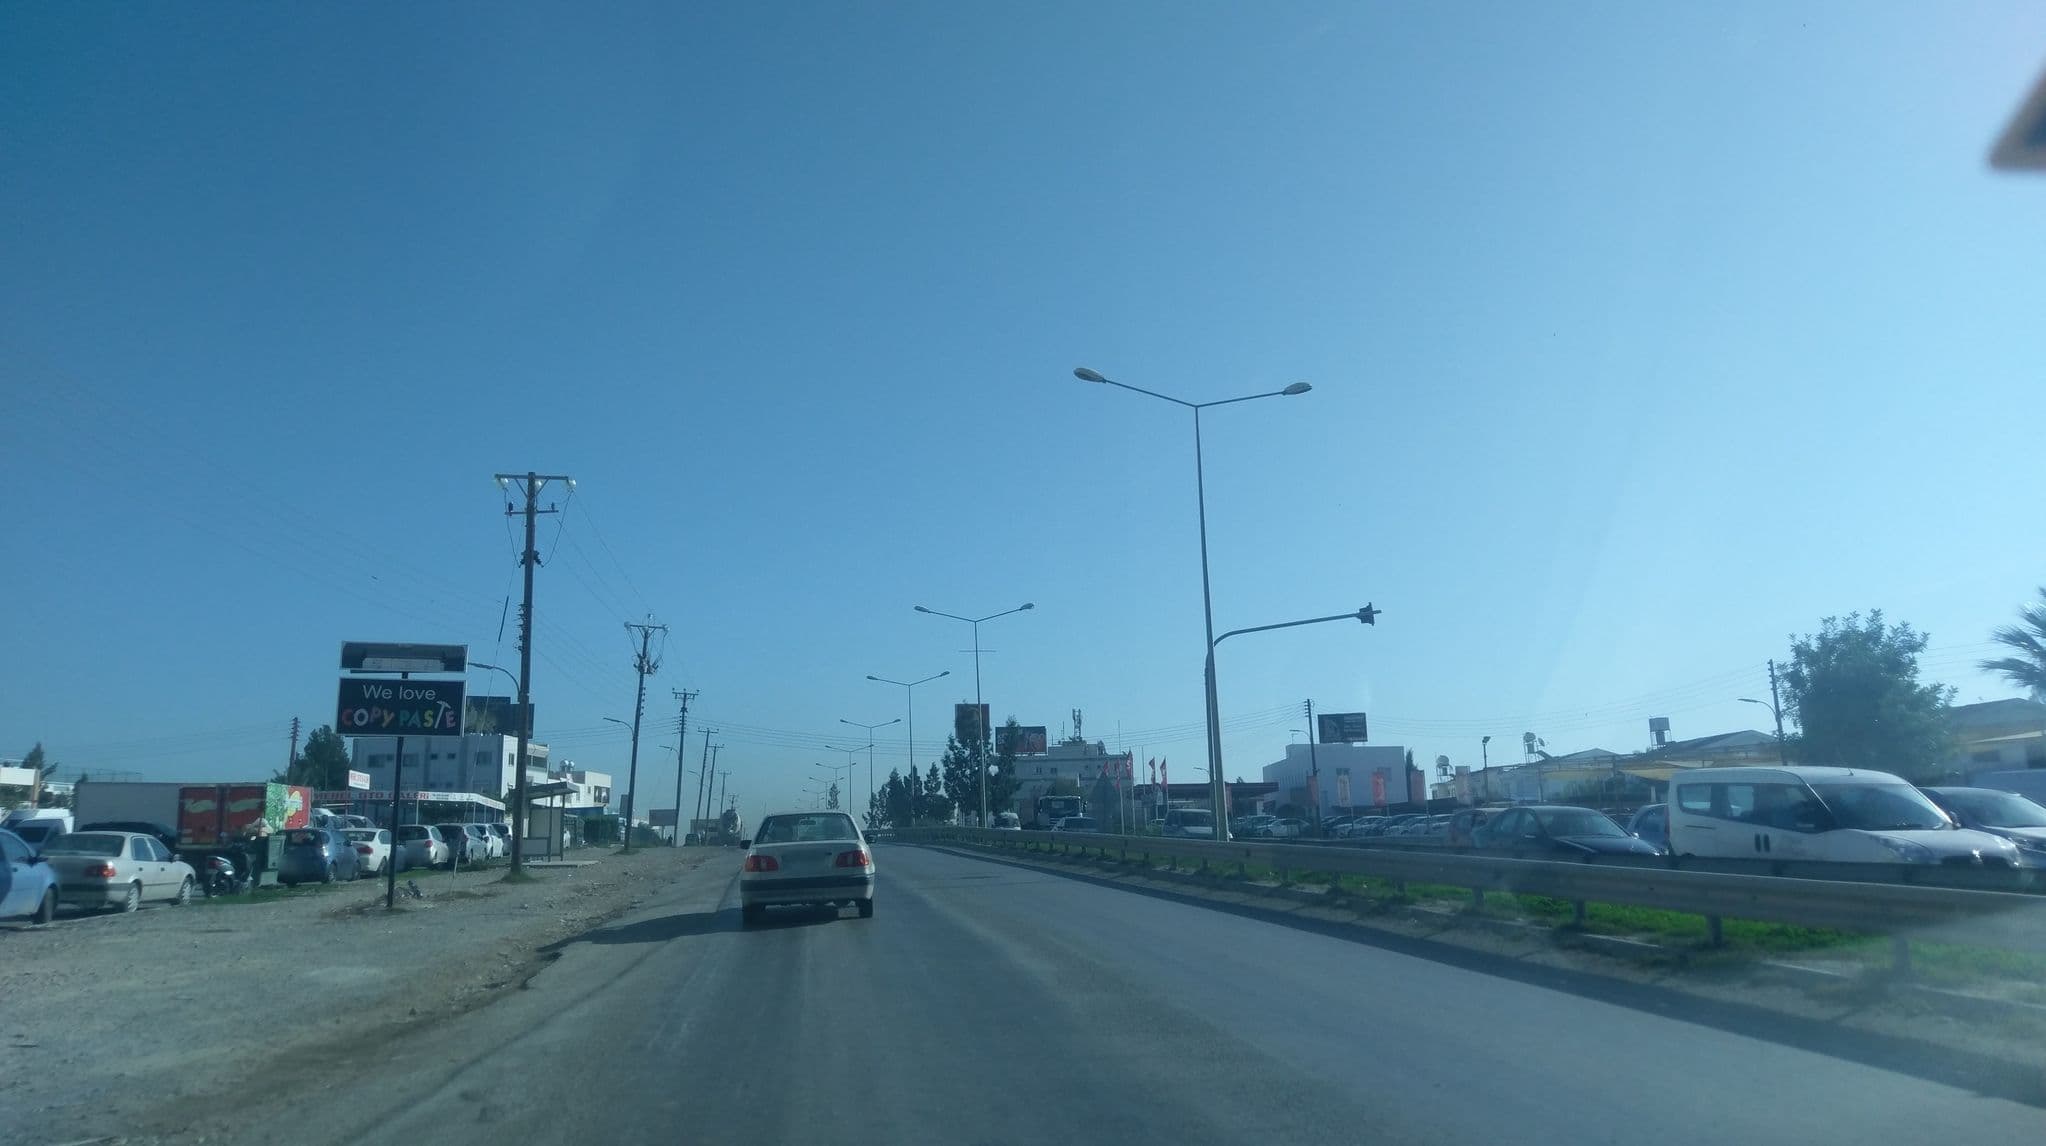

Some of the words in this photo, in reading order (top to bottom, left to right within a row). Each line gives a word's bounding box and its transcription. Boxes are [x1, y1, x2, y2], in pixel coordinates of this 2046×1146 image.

[363, 685, 392, 699] We
[399, 686, 436, 700] love
[341, 707, 395, 728] COPY
[399, 701, 456, 729] PASTE
